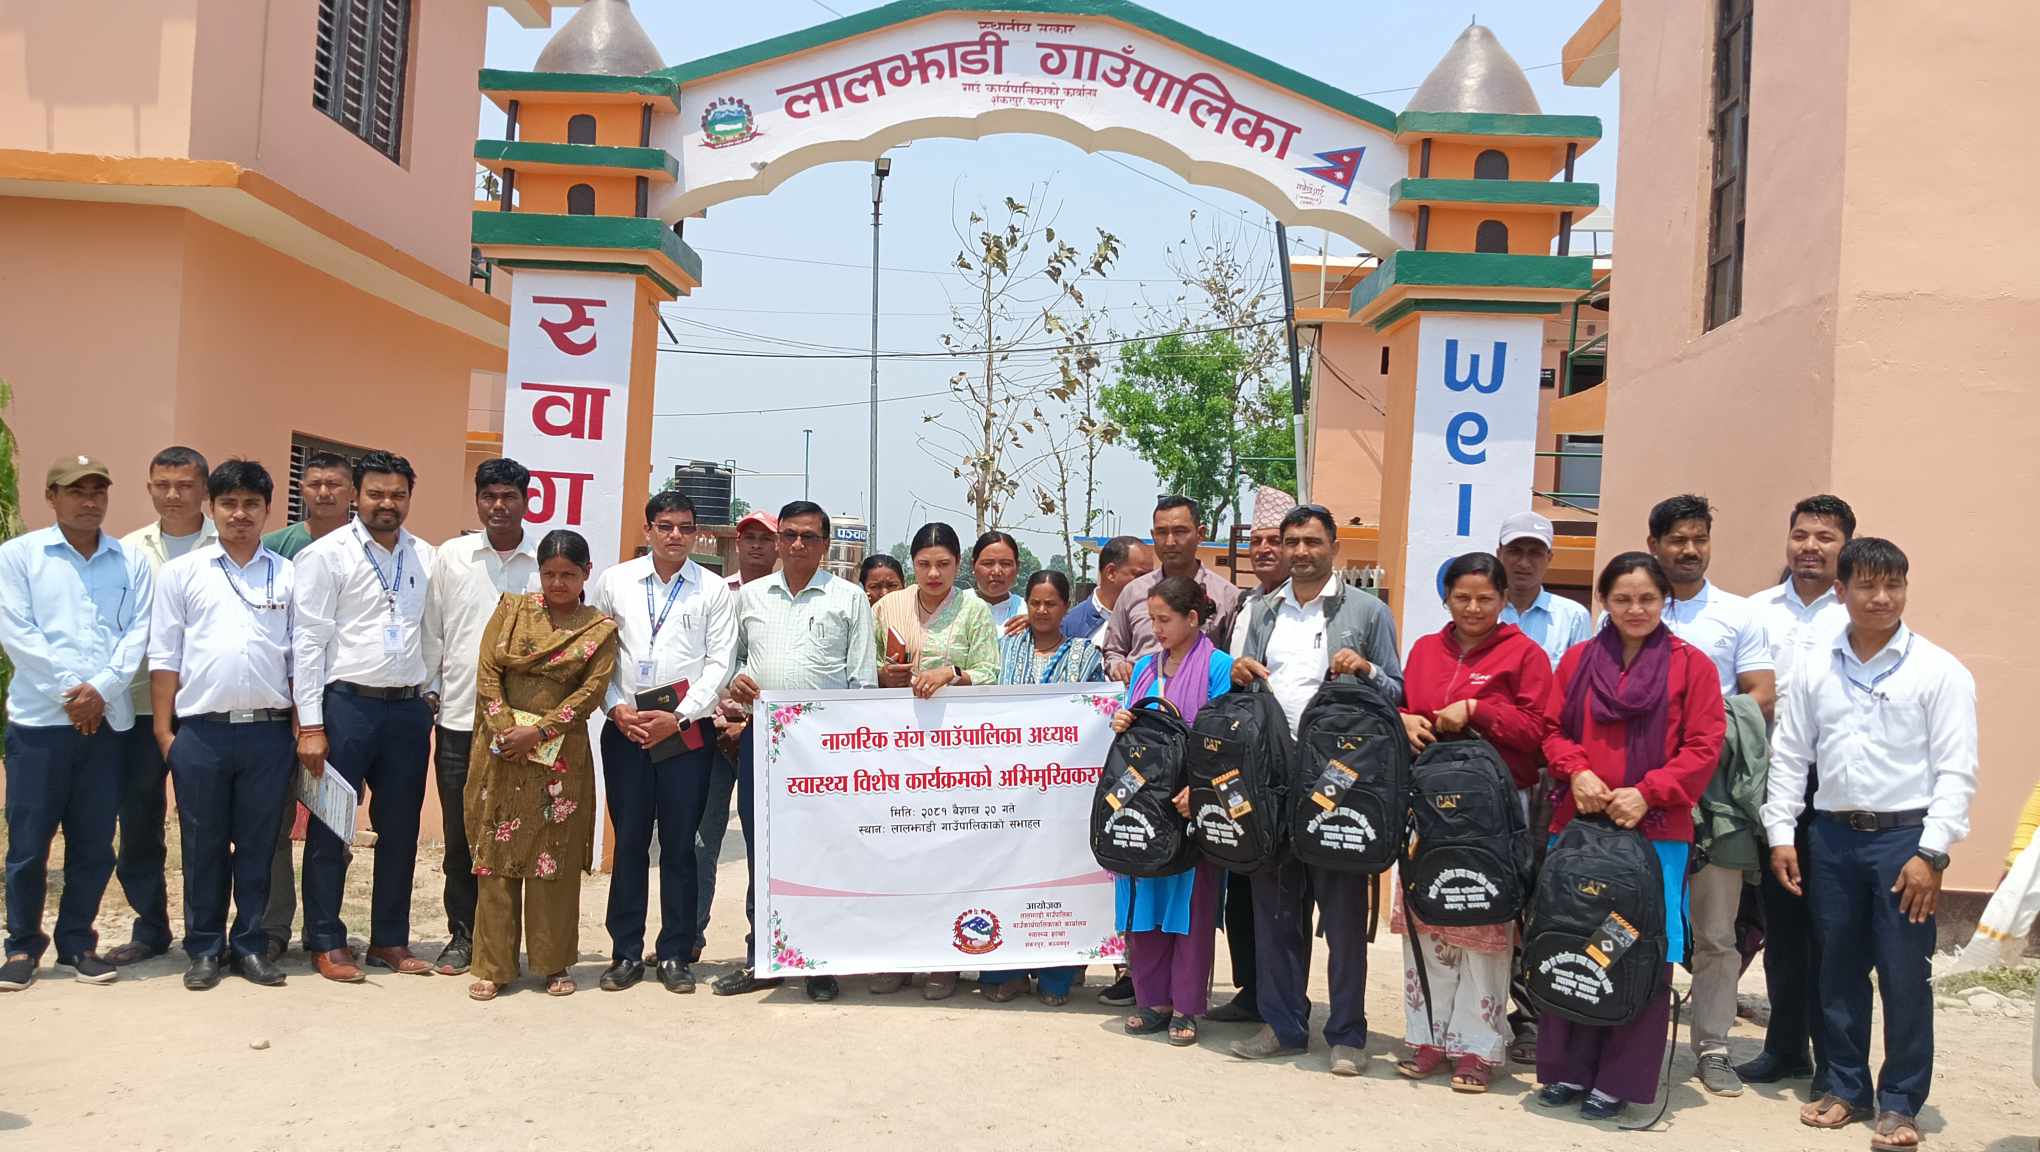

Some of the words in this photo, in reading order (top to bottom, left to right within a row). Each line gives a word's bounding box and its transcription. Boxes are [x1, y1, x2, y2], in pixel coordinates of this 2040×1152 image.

[776, 31, 1009, 119] लालझाडी
[1036, 42, 1302, 160] गाउँपालिका
[821, 726, 888, 750] नागरिक
[893, 725, 924, 748] संग
[1028, 725, 1079, 744] अध्यक्ष
[1203, 735, 1221, 752] CAT
[786, 775, 848, 794] स्वास्थ्य
[853, 768, 900, 792] विशेष
[904, 764, 992, 790] कार्यक्रमको
[1435, 794, 1461, 808] CAT
[921, 807, 947, 818] २०८१
[984, 805, 997, 816] २०
[1002, 802, 1016, 813] गते
[891, 820, 936, 833] लालझाडी
[1025, 900, 1063, 910] आयोजक
